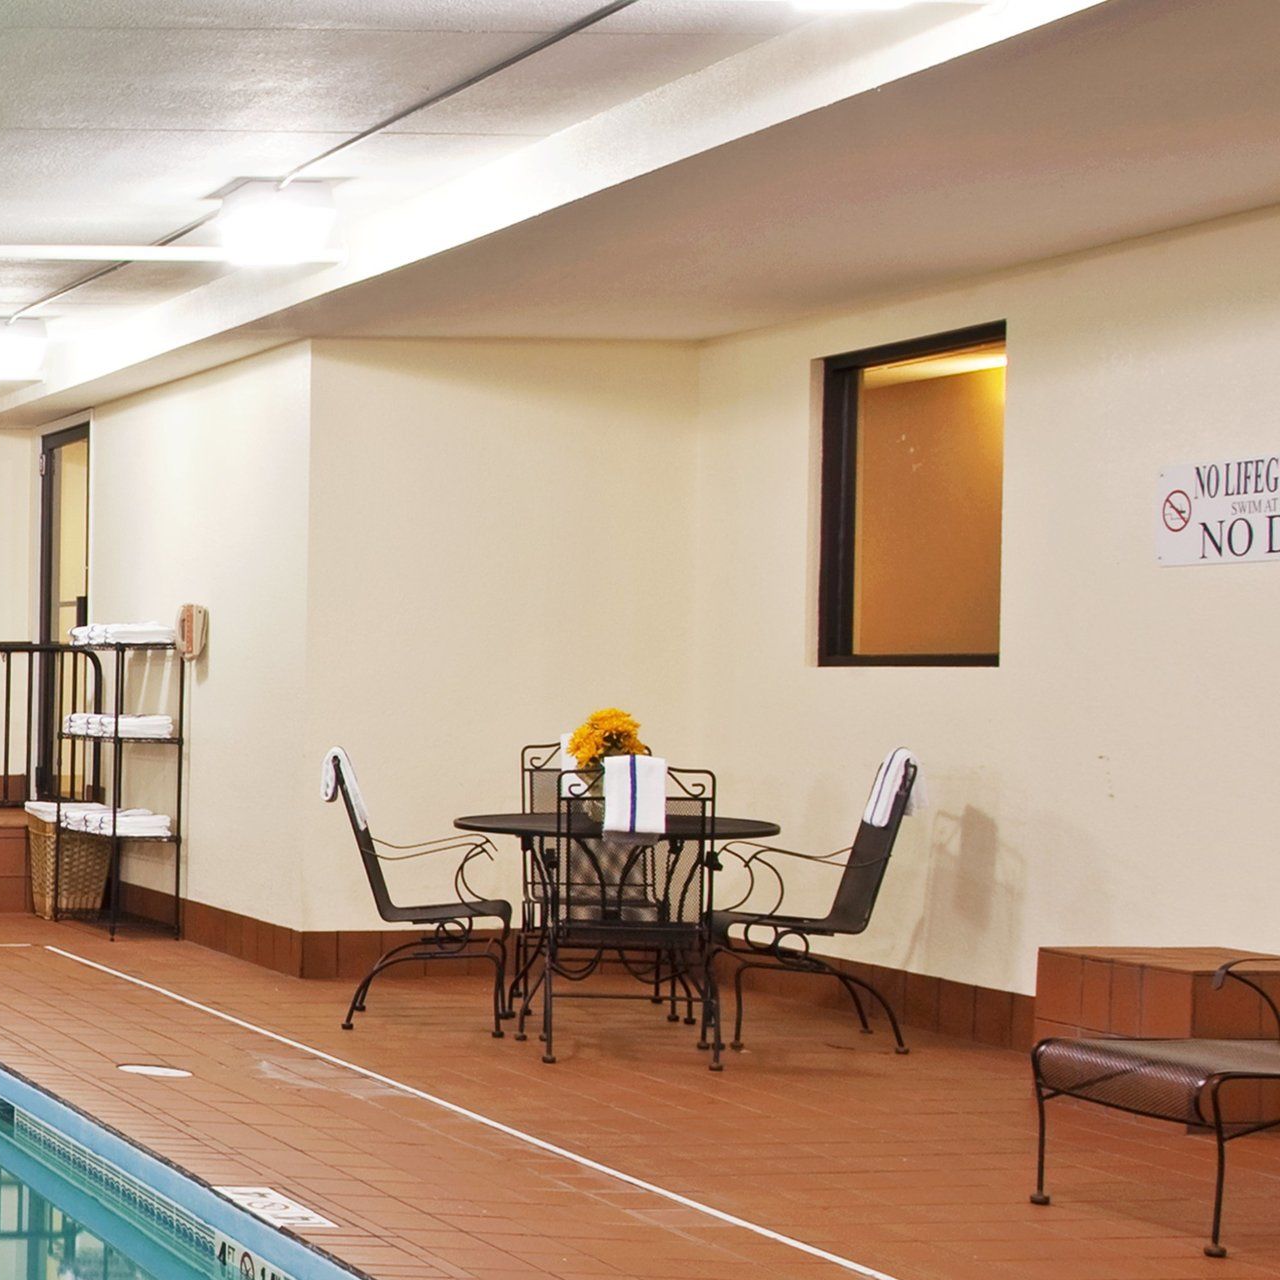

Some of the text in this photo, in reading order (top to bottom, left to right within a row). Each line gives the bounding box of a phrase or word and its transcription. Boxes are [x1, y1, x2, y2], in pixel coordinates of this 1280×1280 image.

[1194, 457, 1279, 499] NO LIFEG
[1231, 498, 1279, 515] SWIM AT
[1198, 518, 1254, 559] NO
